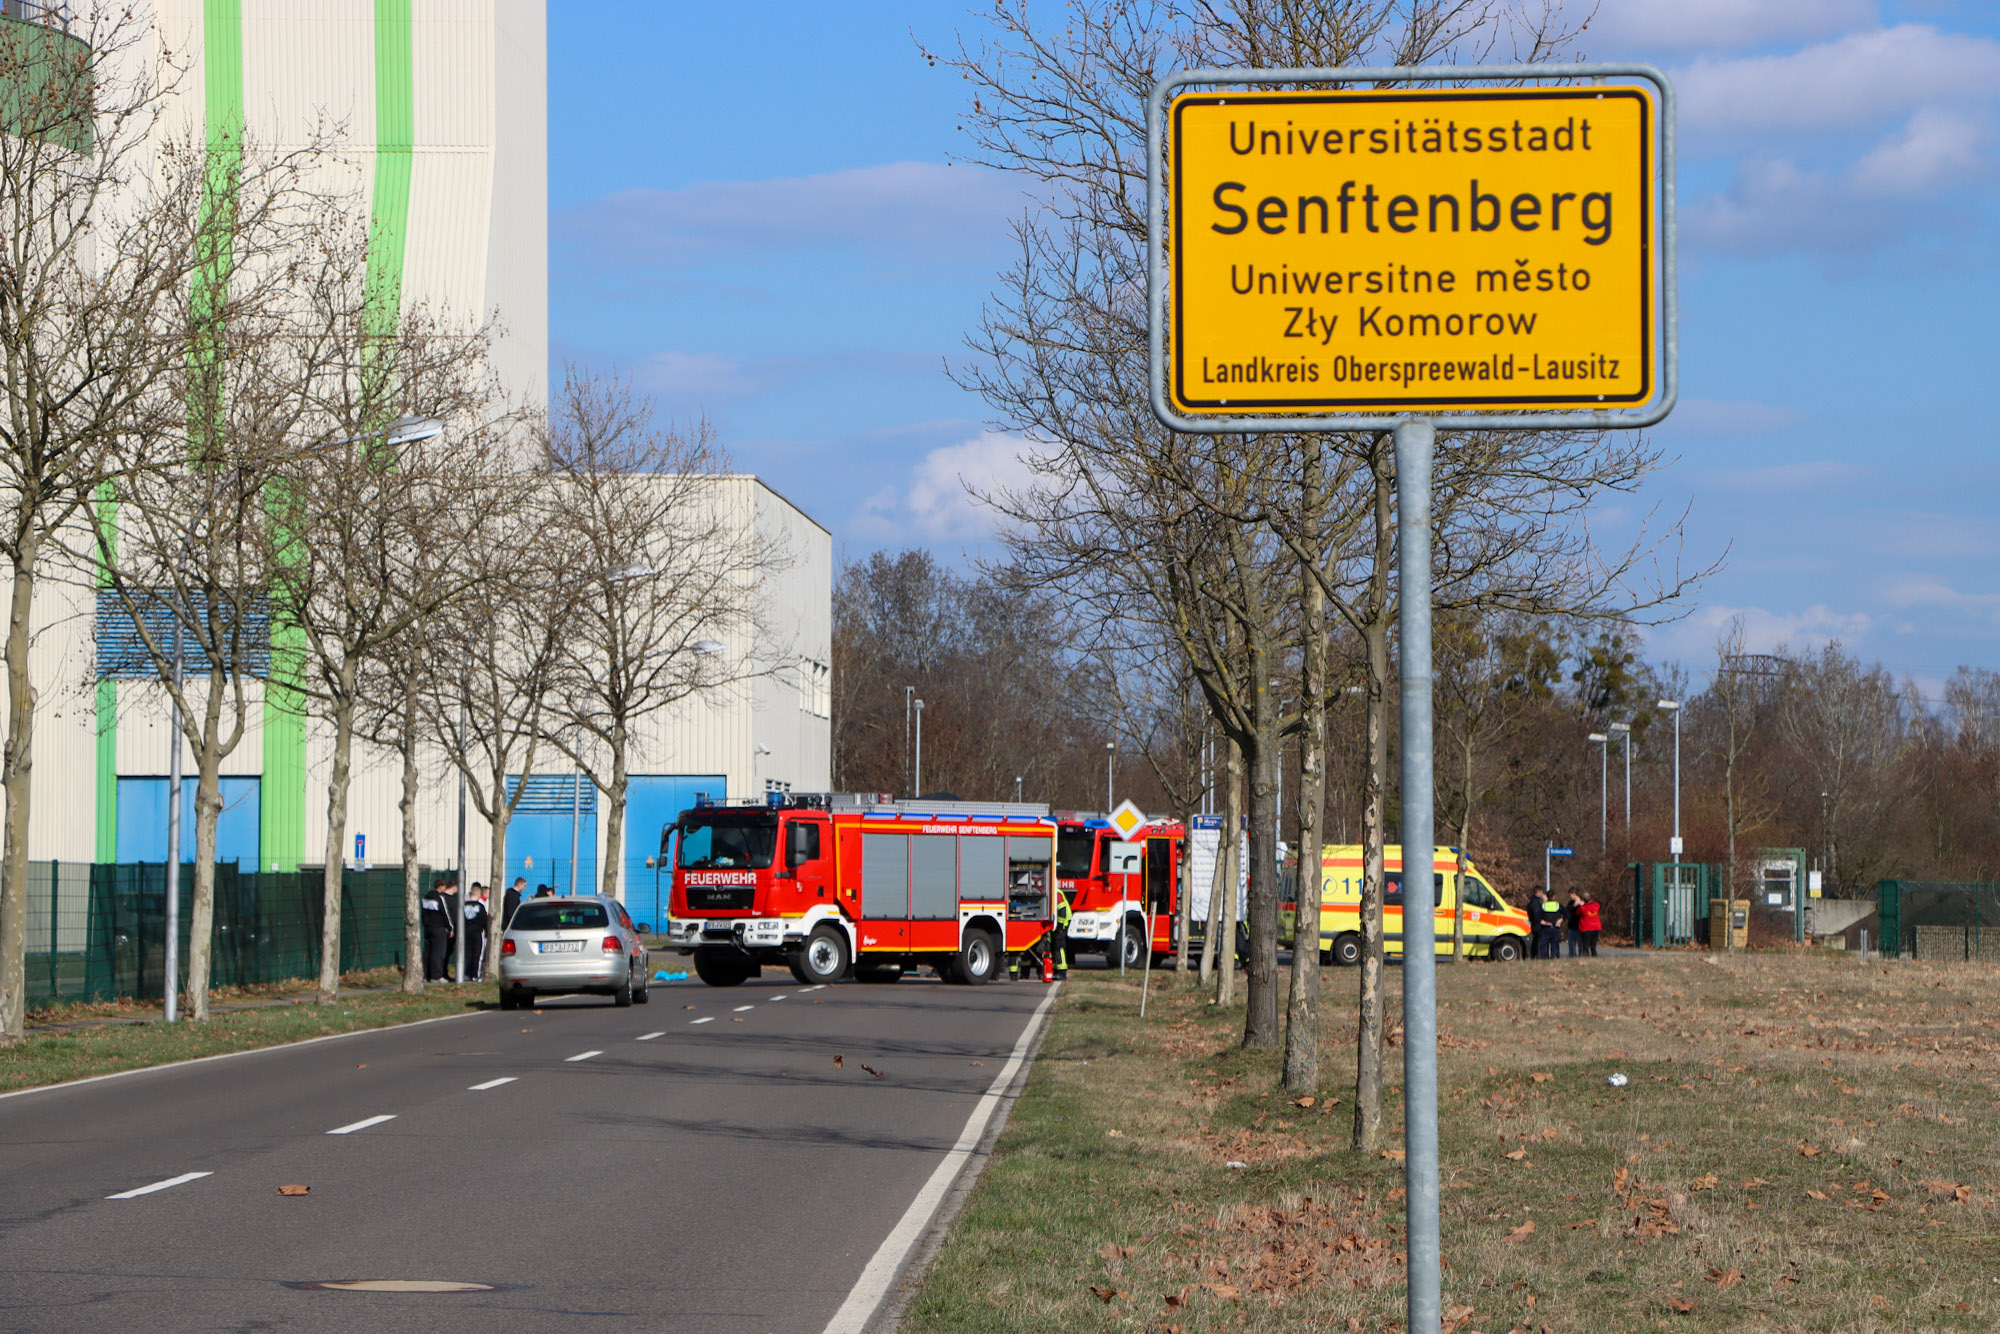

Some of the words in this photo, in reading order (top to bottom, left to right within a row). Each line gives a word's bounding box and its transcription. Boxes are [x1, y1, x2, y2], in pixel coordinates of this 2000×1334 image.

[1229, 117, 1592, 156] Universitätsstadt
[1211, 179, 1613, 246] Senftenberg
[1231, 262, 1456, 295] Uniwersitne
[1476, 258, 1591, 292] město
[1283, 306, 1339, 346] Zły
[1359, 306, 1538, 337] Komorow
[1203, 355, 1320, 384] Landkreis
[1333, 352, 1620, 389] Oberspreewald-Lausitz
[922, 824, 958, 834] FEUERWEHR
[958, 825, 998, 835] SENFTENBERG
[684, 872, 757, 885] FEUERWEHR
[1341, 877, 1363, 895] 11
